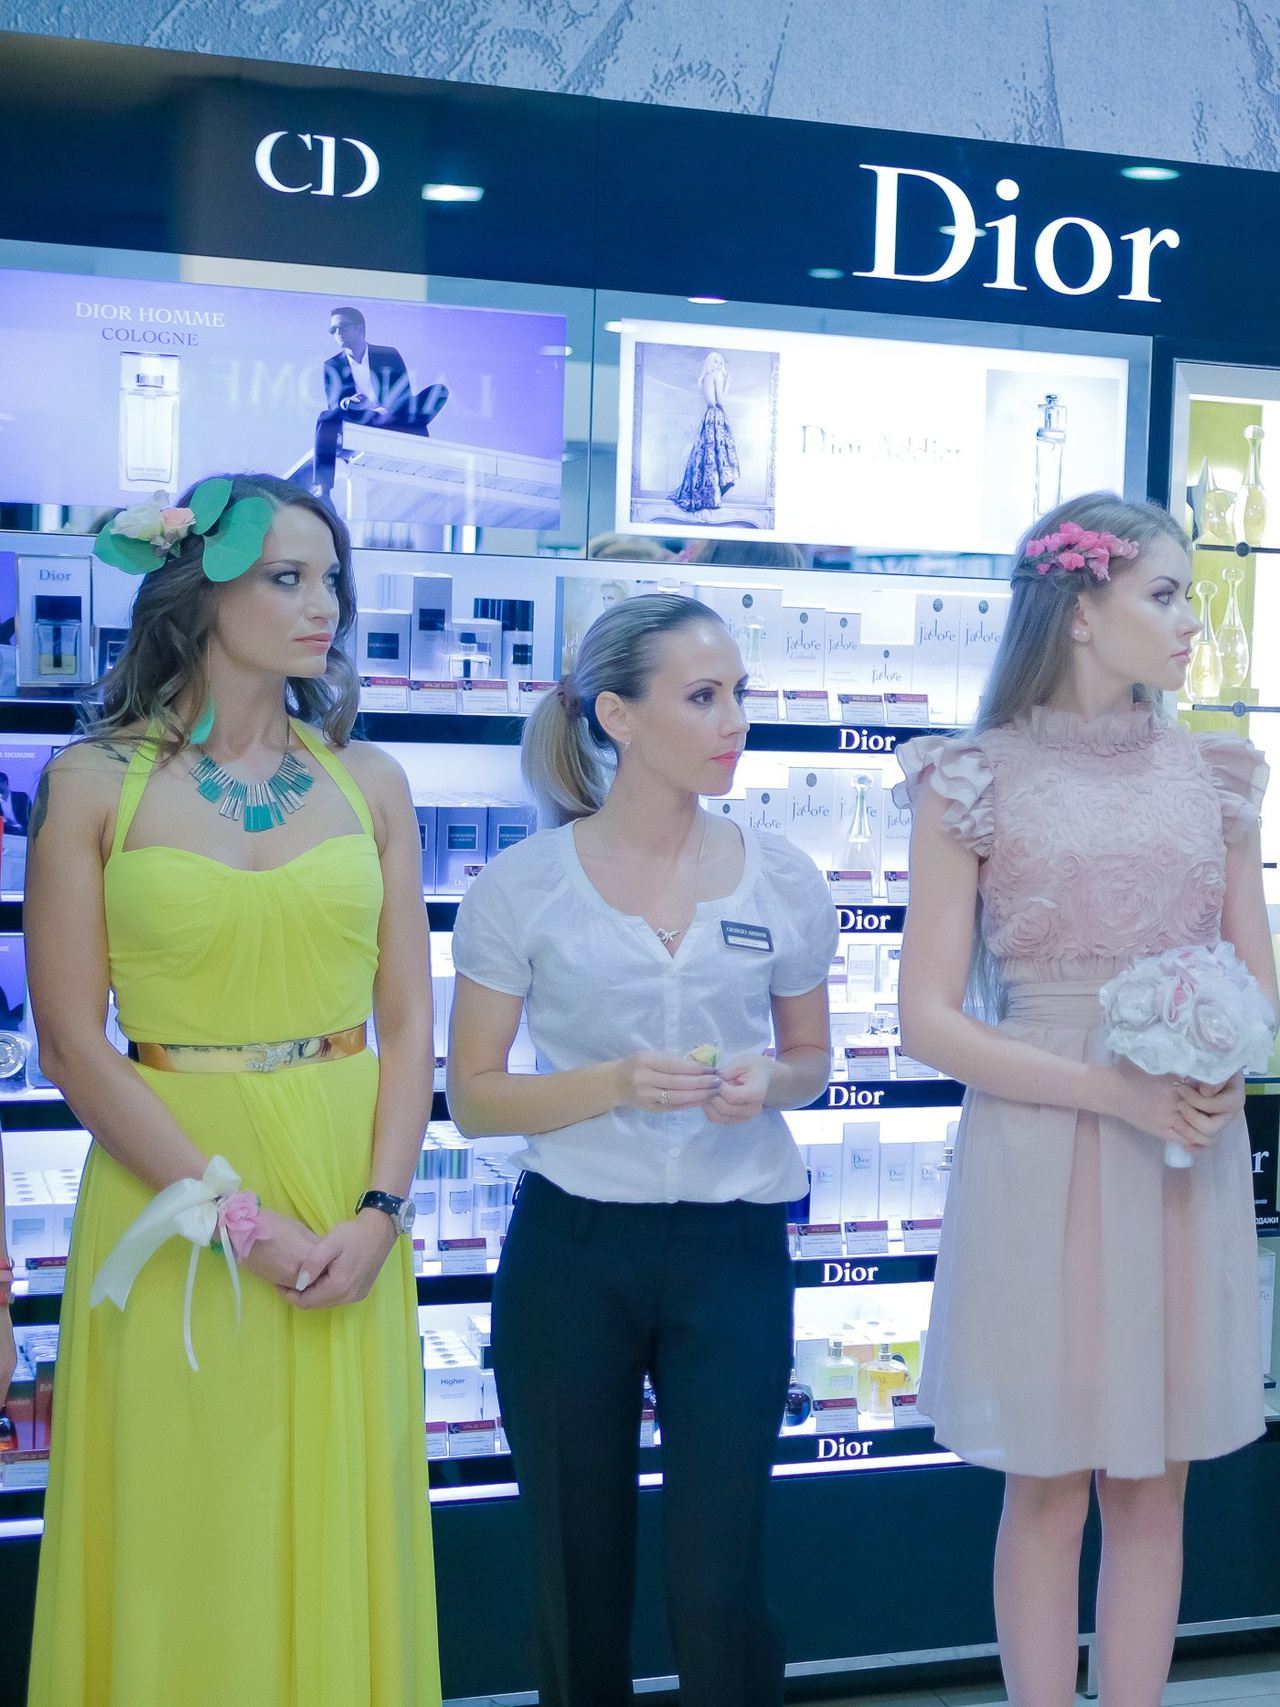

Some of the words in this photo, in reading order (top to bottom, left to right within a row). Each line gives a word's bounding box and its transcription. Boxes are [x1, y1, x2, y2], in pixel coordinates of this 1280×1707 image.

[852, 164, 1180, 303] Dior
[76, 302, 132, 321] DIOR
[138, 307, 226, 327] HOMME
[102, 328, 198, 346] COLOGNE
[39, 569, 72, 581] Dior
[838, 729, 896, 751] Dior
[838, 907, 891, 931] Dior
[828, 1085, 884, 1106] Dior
[822, 1263, 878, 1284] Dior
[440, 1378, 465, 1386] Higher
[817, 1437, 873, 1459] Dior
